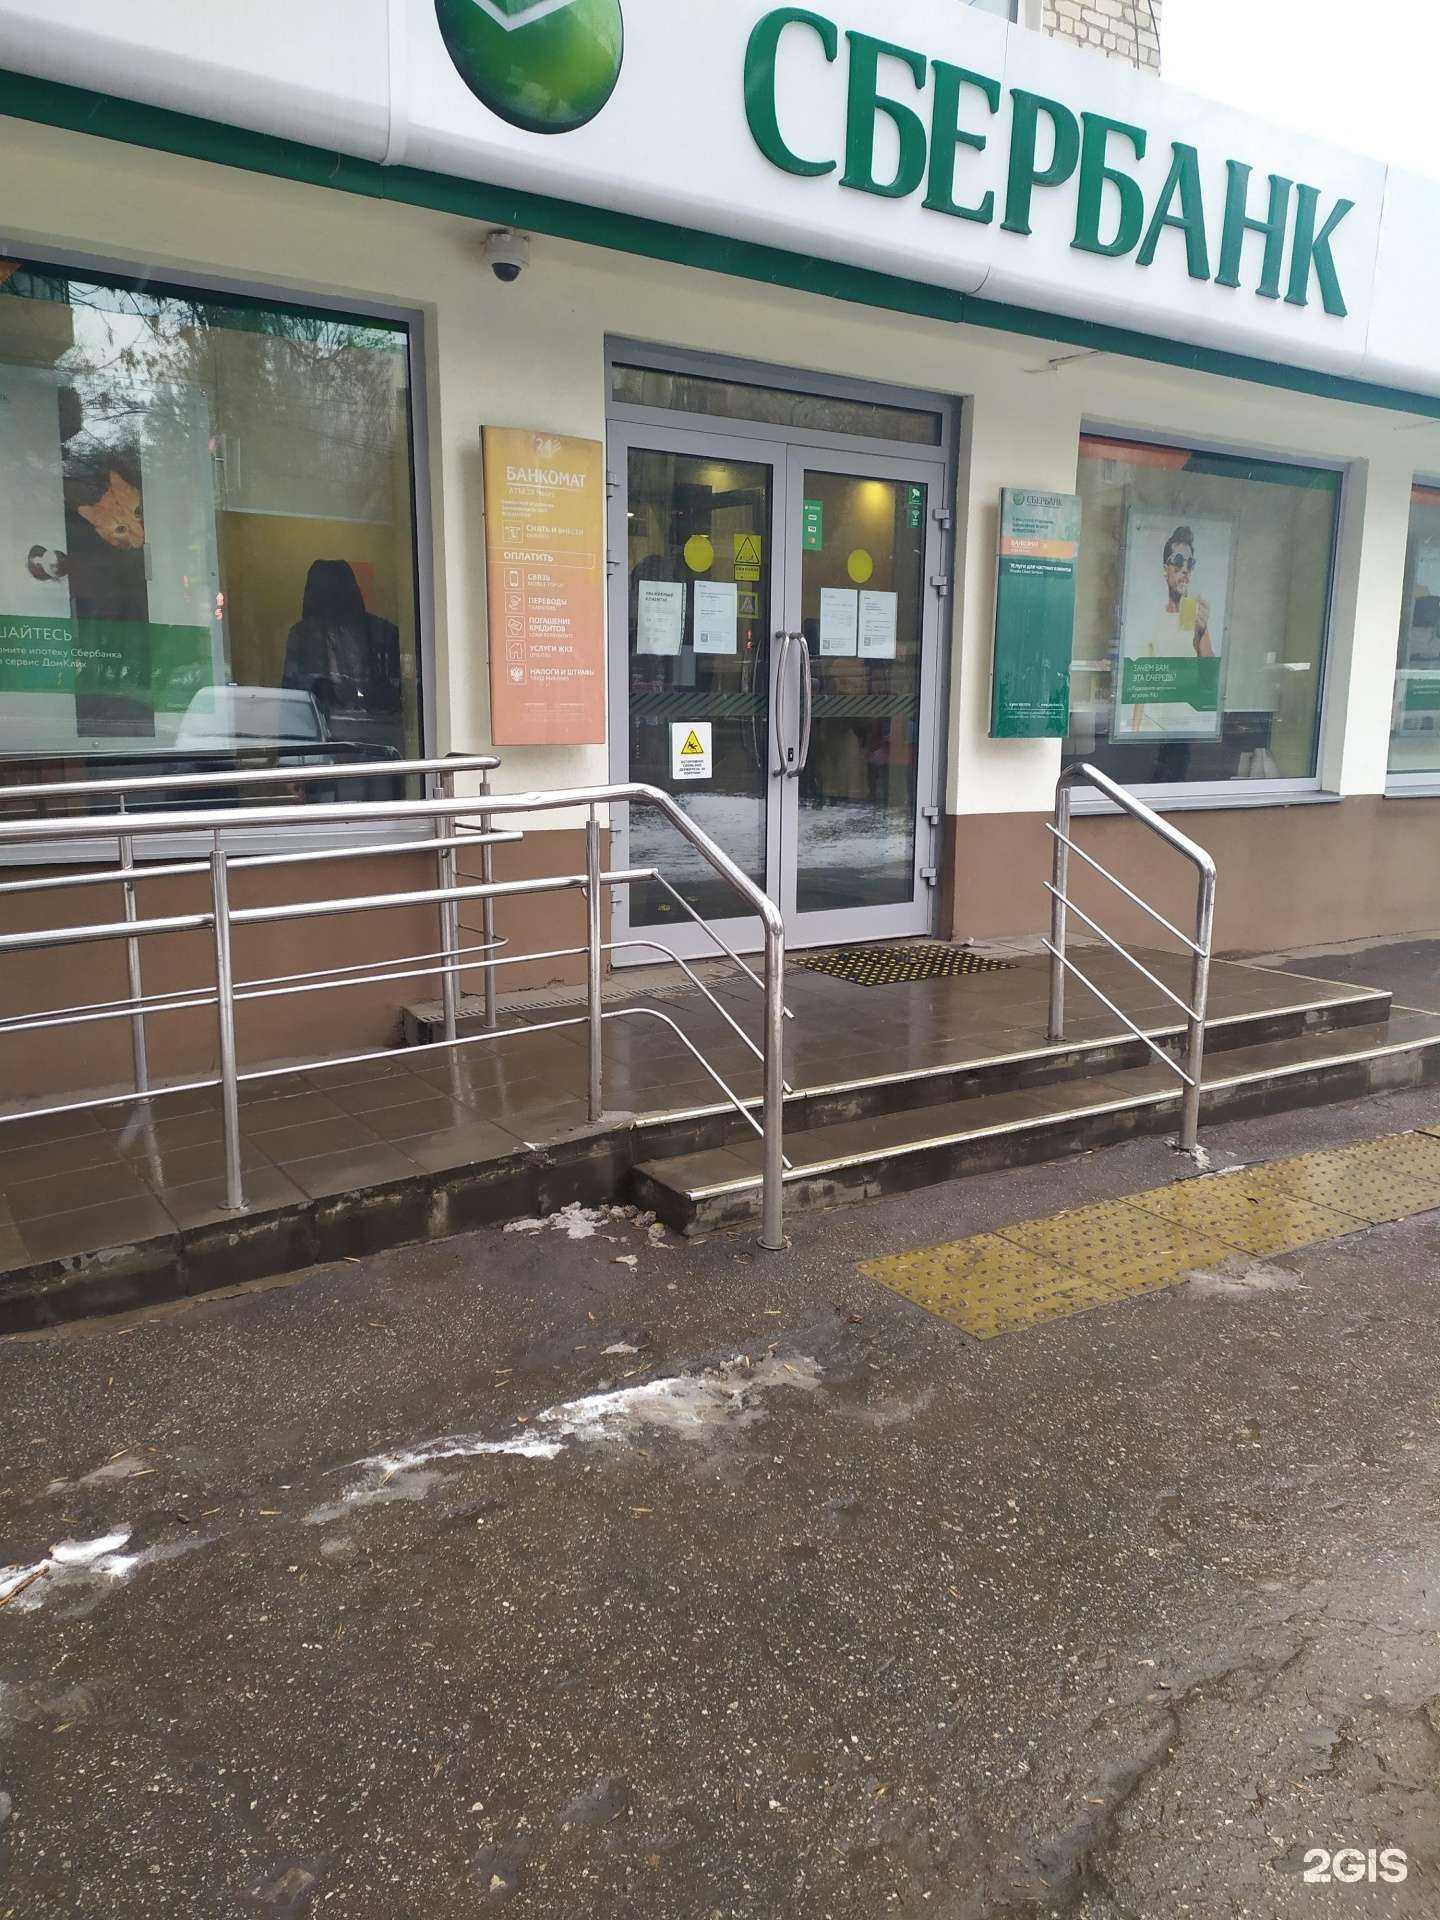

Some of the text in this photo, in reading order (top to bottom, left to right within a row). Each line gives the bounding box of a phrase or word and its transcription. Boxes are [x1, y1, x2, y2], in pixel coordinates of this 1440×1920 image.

[743, 6, 1356, 318] СБЕРБАНК
[506, 465, 586, 488] БАНКОМАТ
[503, 551, 554, 562] ОПЛАТИТЬ
[528, 597, 567, 606] ПЕРЕВОДЫ
[529, 617, 570, 625] ПОГАШЕНИЕ
[28, 648, 68, 657] ипотеку
[70, 648, 122, 659] Сбербанка
[530, 645, 557, 653] УСЛУГИ
[5, 658, 40, 668] сервис
[42, 657, 88, 668] ДомКлик
